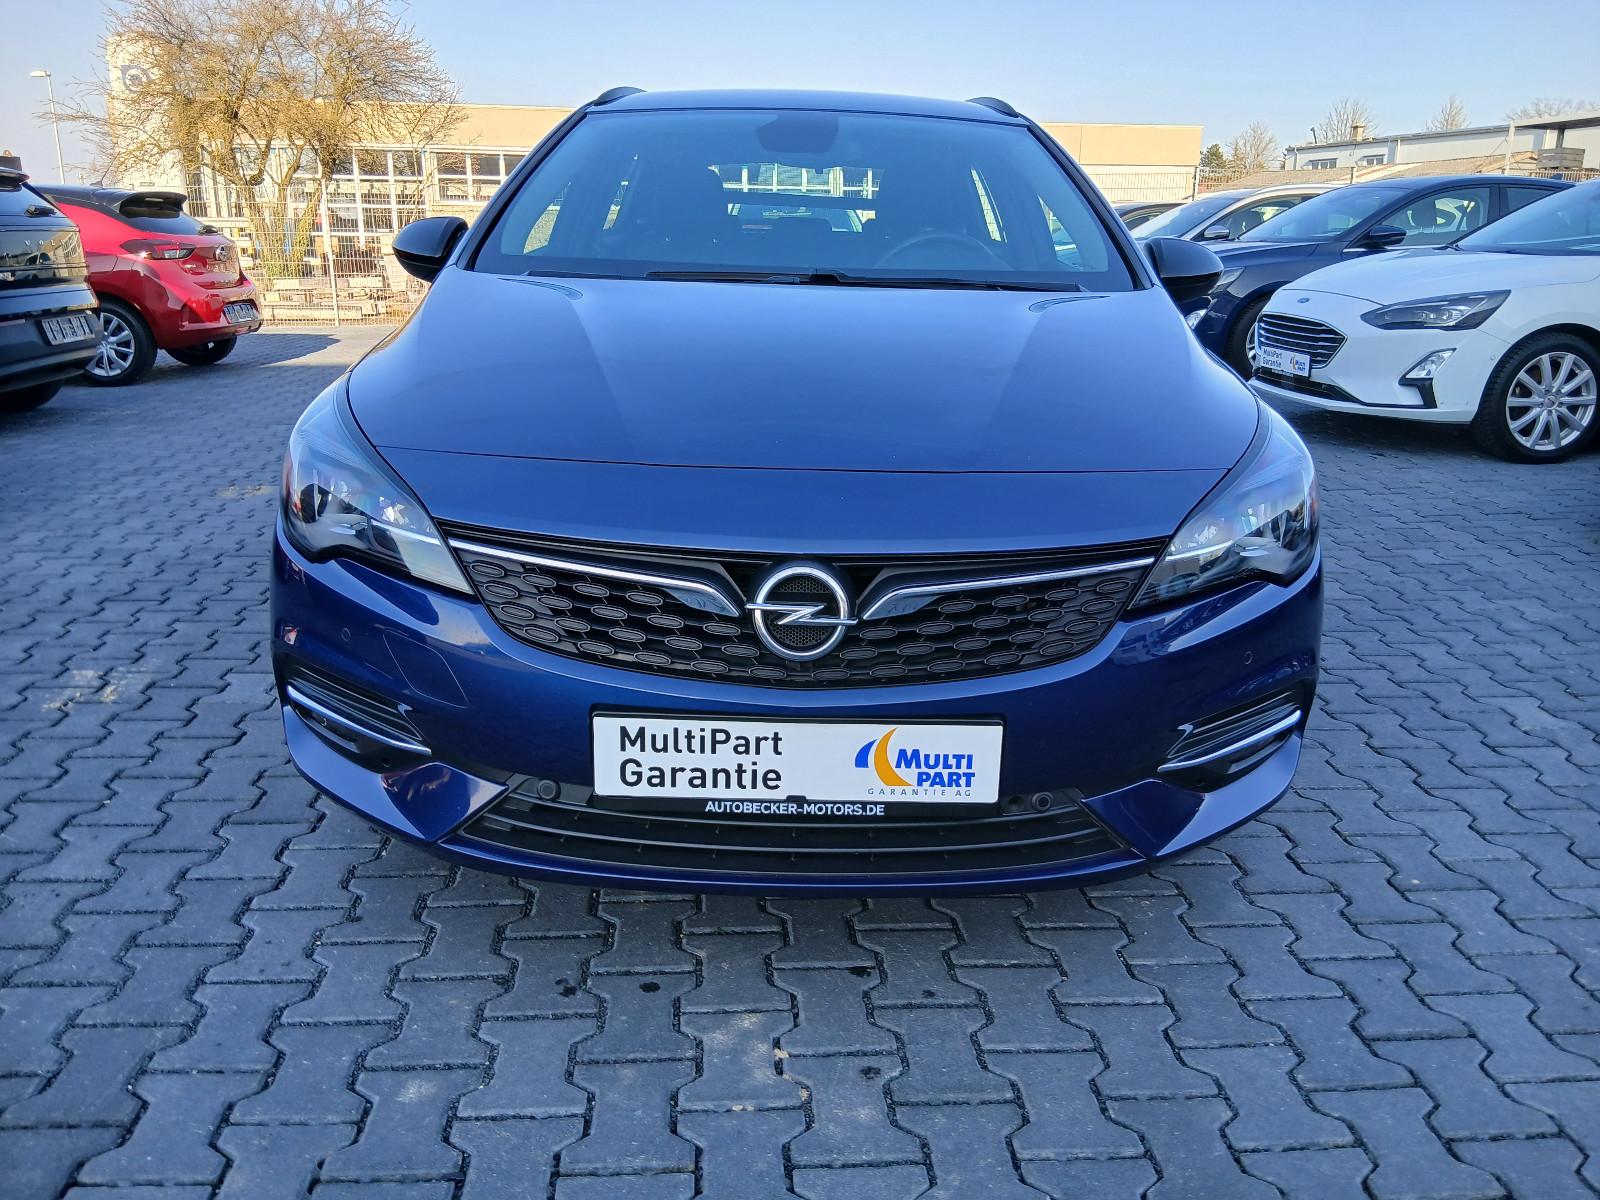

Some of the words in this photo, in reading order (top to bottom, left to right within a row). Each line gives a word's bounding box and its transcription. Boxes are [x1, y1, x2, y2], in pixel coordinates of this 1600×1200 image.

[619, 725, 783, 756] MultiPart
[895, 748, 974, 770] MULTI
[619, 757, 782, 791] Garantie
[916, 771, 976, 788] PART
[867, 787, 947, 797] GARANTIE
[955, 789, 971, 797] AG
[704, 800, 886, 816] AUTOBECKER-MOTORS.DE
